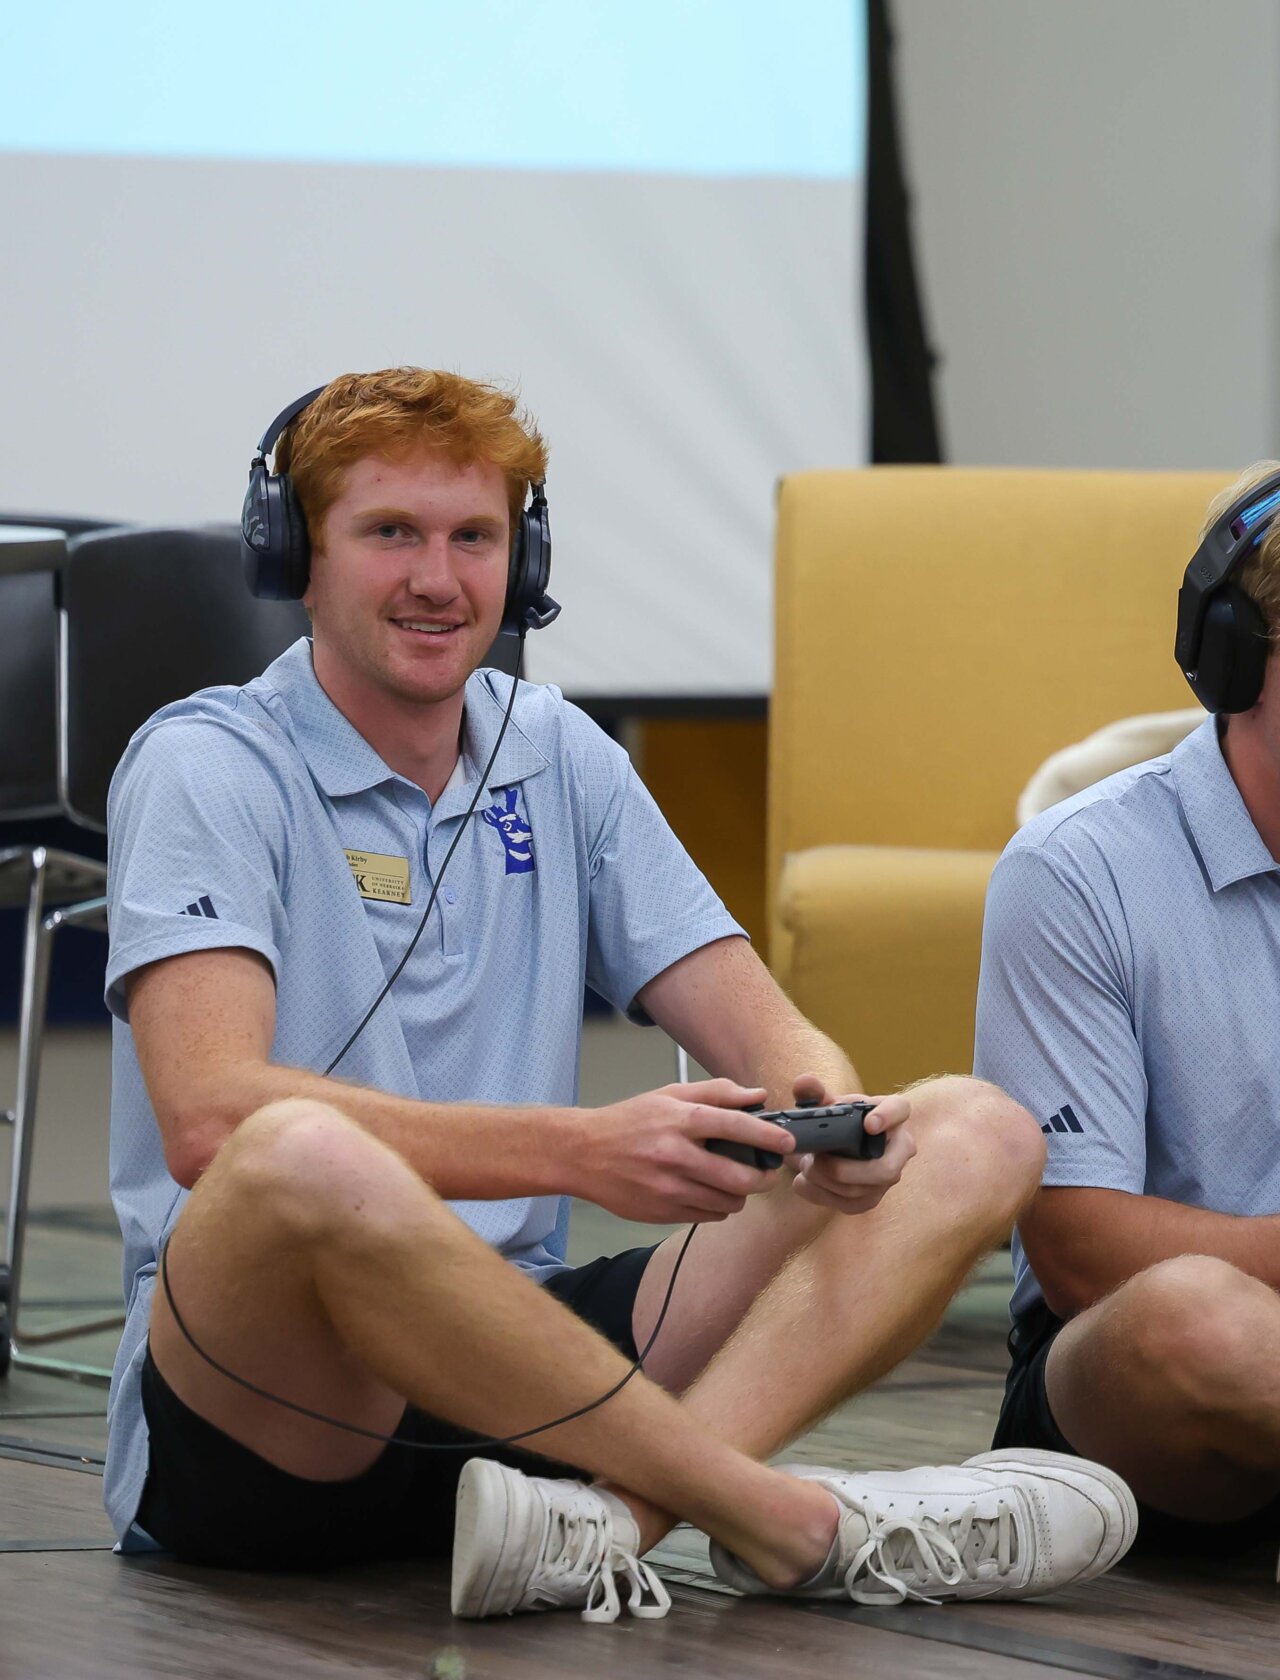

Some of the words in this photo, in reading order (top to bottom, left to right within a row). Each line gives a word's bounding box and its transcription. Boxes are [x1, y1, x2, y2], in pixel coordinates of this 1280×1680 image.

[351, 855, 367, 864] Kirby
[372, 877, 404, 885] UNIVERSITY
[373, 888, 405, 898] KEARNEY
